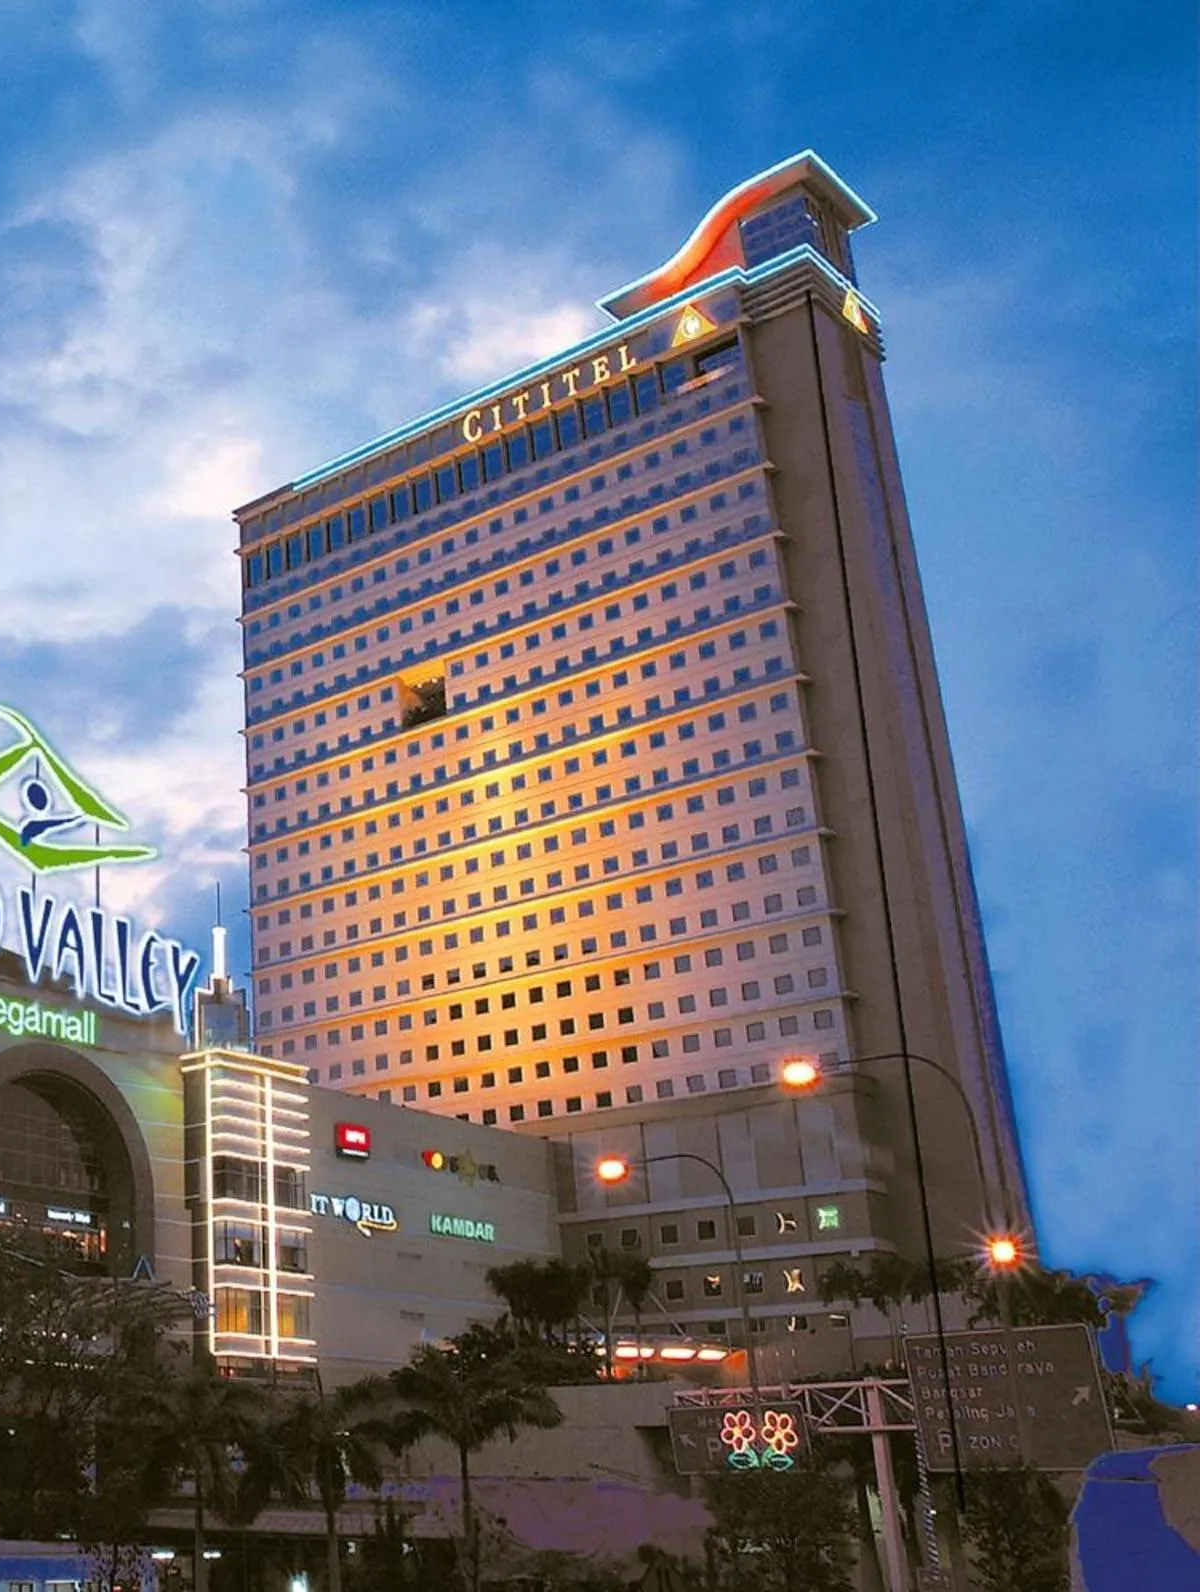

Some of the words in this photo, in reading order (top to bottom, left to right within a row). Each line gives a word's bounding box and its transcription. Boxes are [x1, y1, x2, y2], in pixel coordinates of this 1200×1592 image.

[462, 345, 637, 443] CITITEL
[310, 1193, 329, 1215] IT
[431, 1214, 496, 1242] KAMDAR
